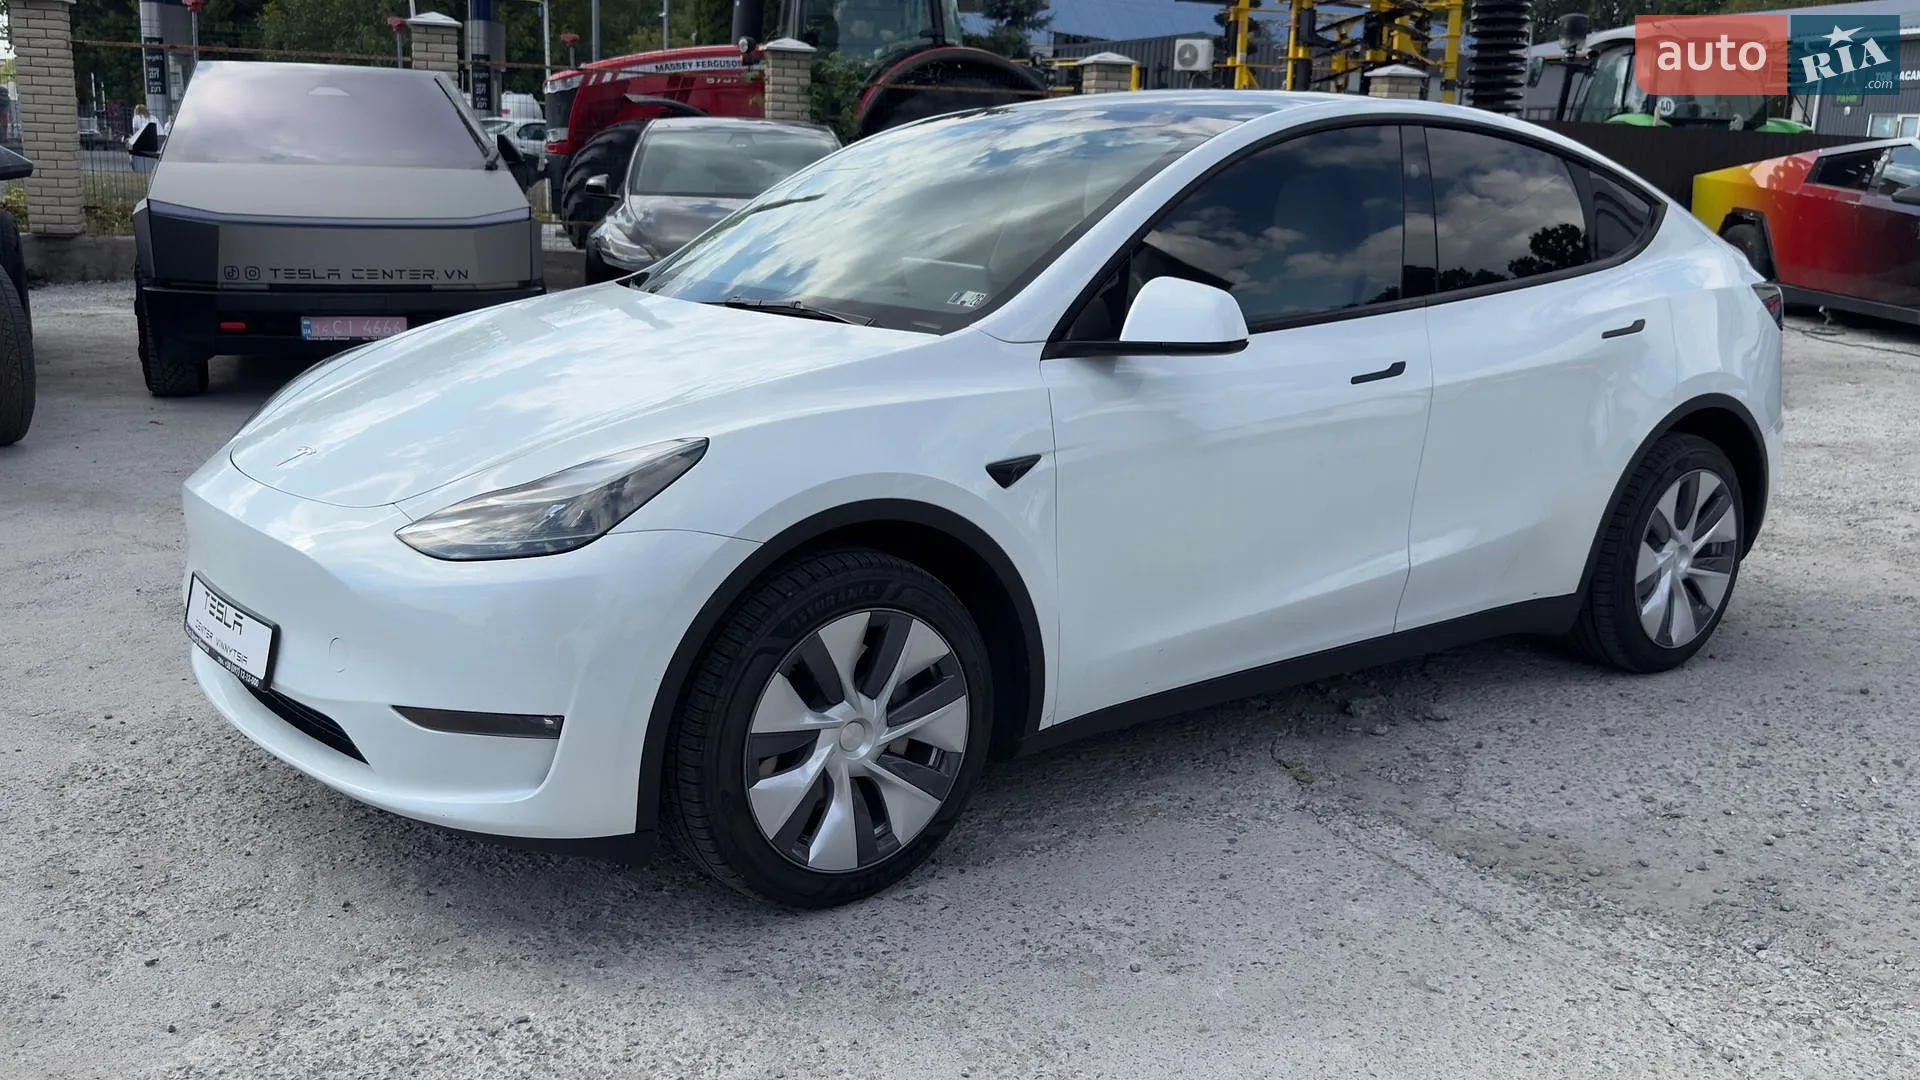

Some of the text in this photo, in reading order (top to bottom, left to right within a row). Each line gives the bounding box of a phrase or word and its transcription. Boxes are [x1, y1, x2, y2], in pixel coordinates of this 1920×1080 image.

[655, 59, 741, 73] MASSEY FERGUSO
[1660, 103, 1672, 112] 40
[269, 268, 341, 280] TESLA
[204, 590, 244, 636] TESLA
